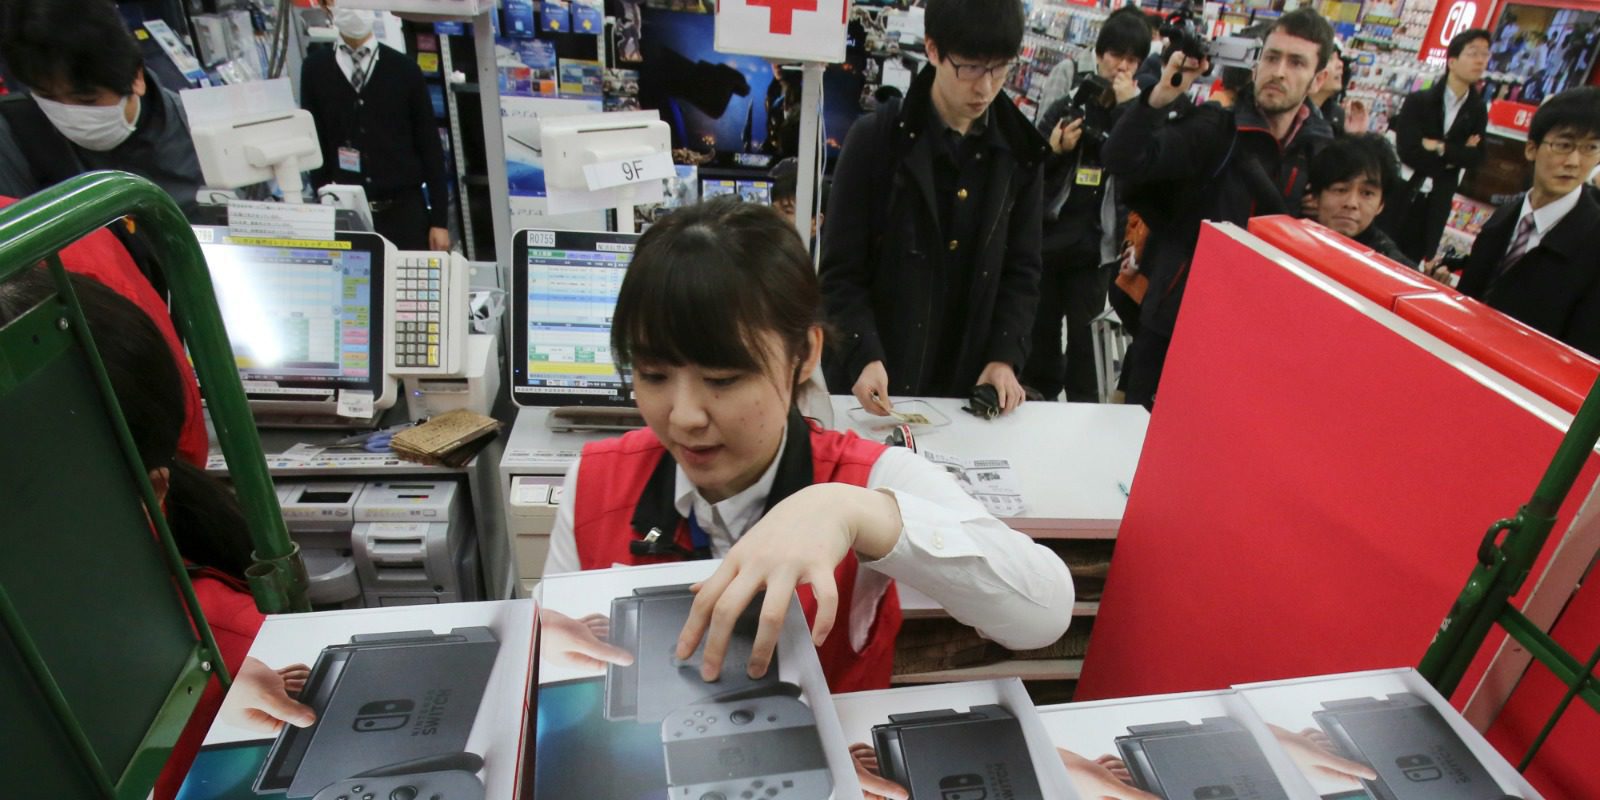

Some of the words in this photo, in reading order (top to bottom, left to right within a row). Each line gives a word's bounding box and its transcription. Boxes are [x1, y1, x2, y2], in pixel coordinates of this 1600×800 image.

[622, 160, 643, 180] 9F
[530, 233, 554, 244] R0755
[422, 688, 452, 736] SWITCH
